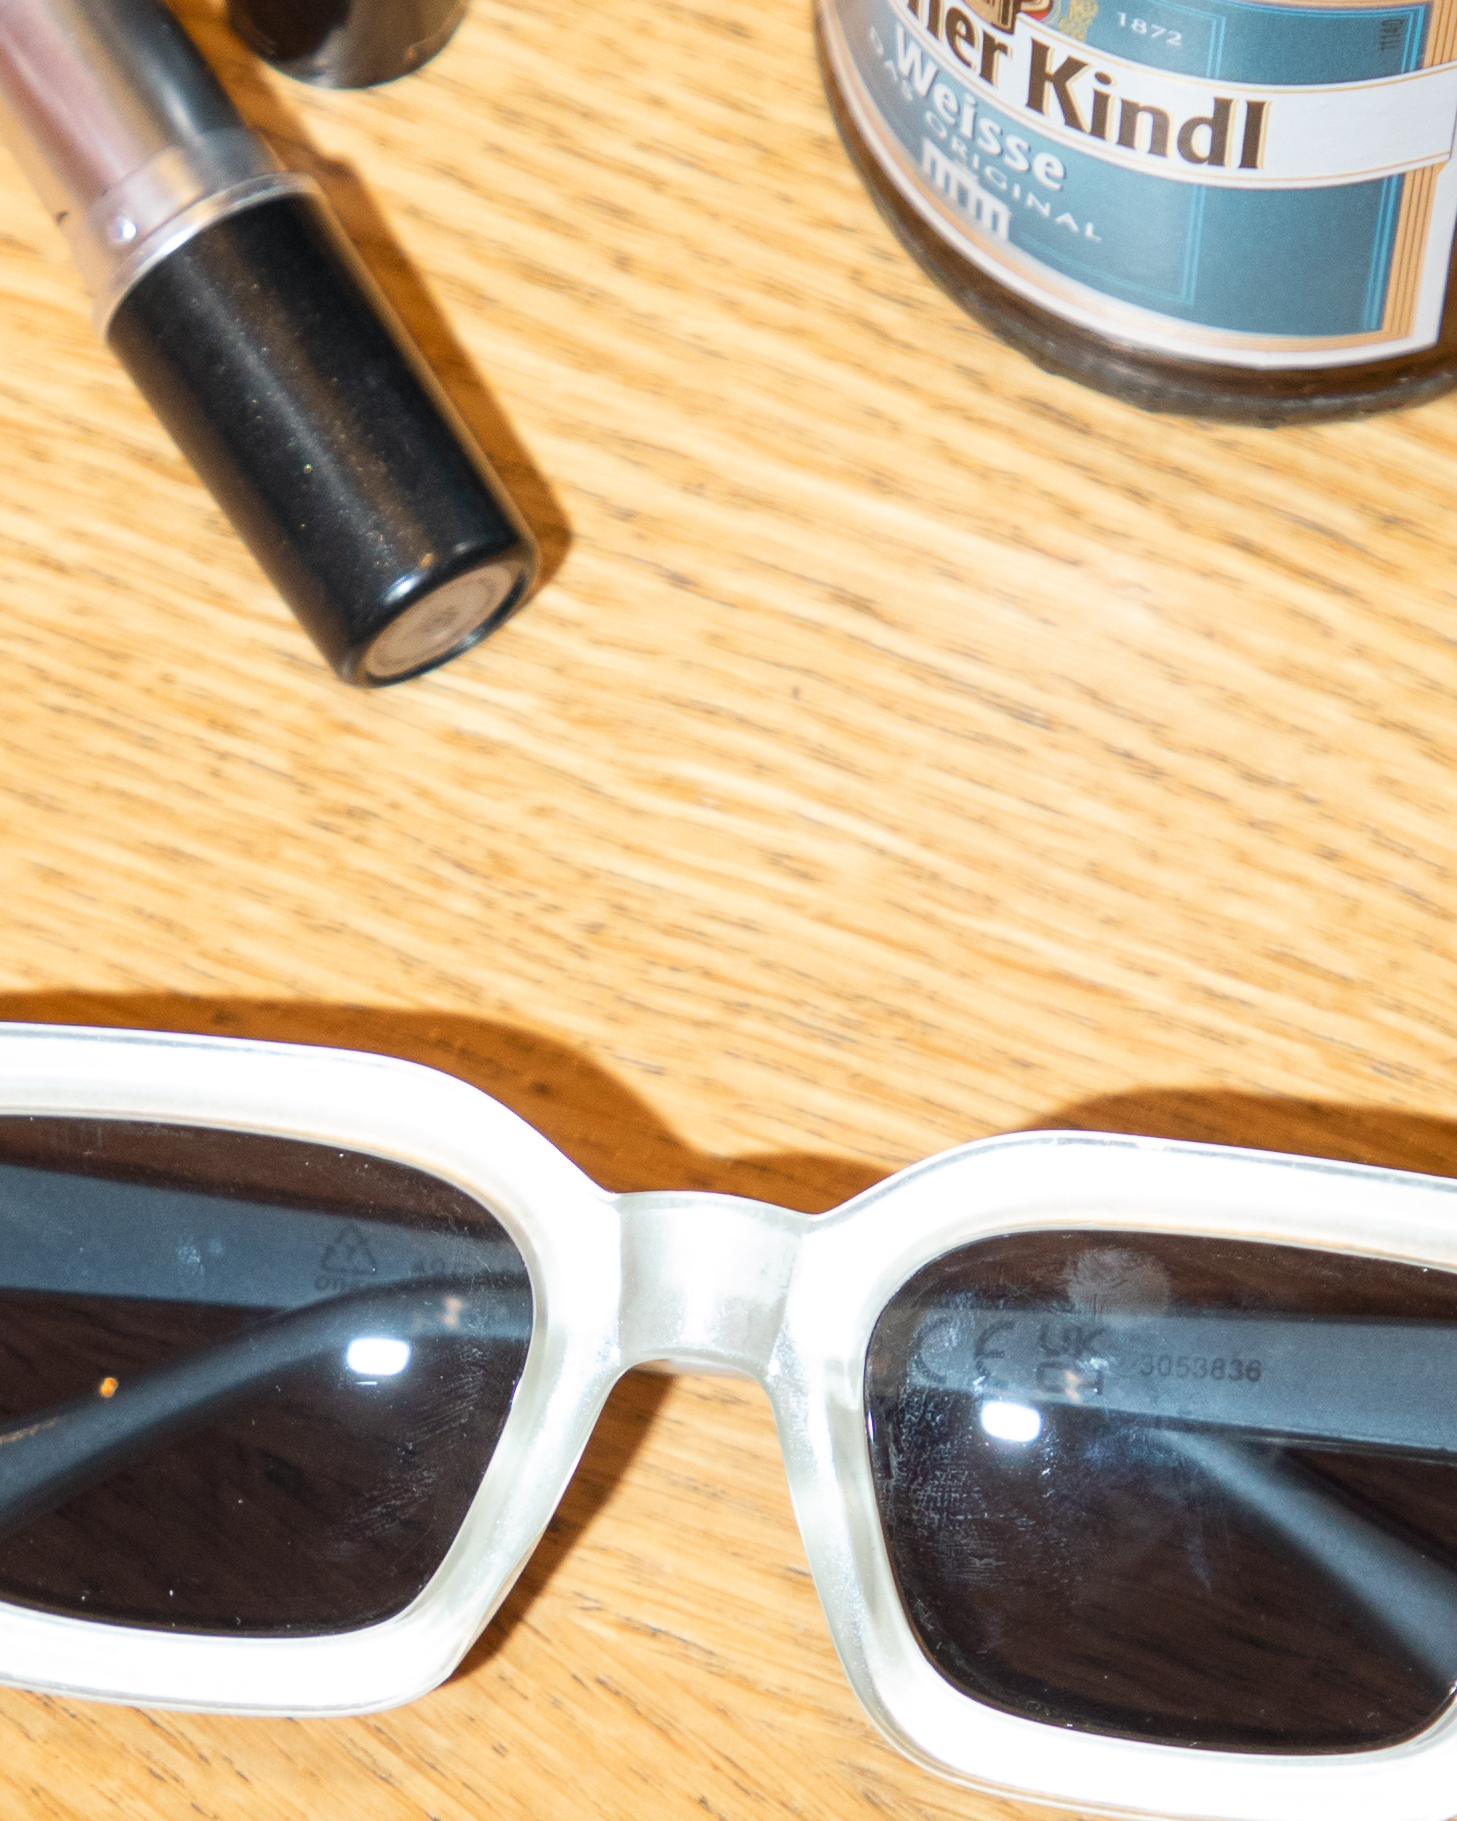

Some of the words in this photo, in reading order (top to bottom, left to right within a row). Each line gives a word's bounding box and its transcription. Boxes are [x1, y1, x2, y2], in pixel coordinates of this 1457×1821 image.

[1024, 36, 1270, 171] Kindl
[1115, 9, 1184, 48] 1872
[869, 25, 914, 103] DAS
[924, 109, 1103, 244] ORIGINAL
[895, 21, 1067, 192] Weisse
